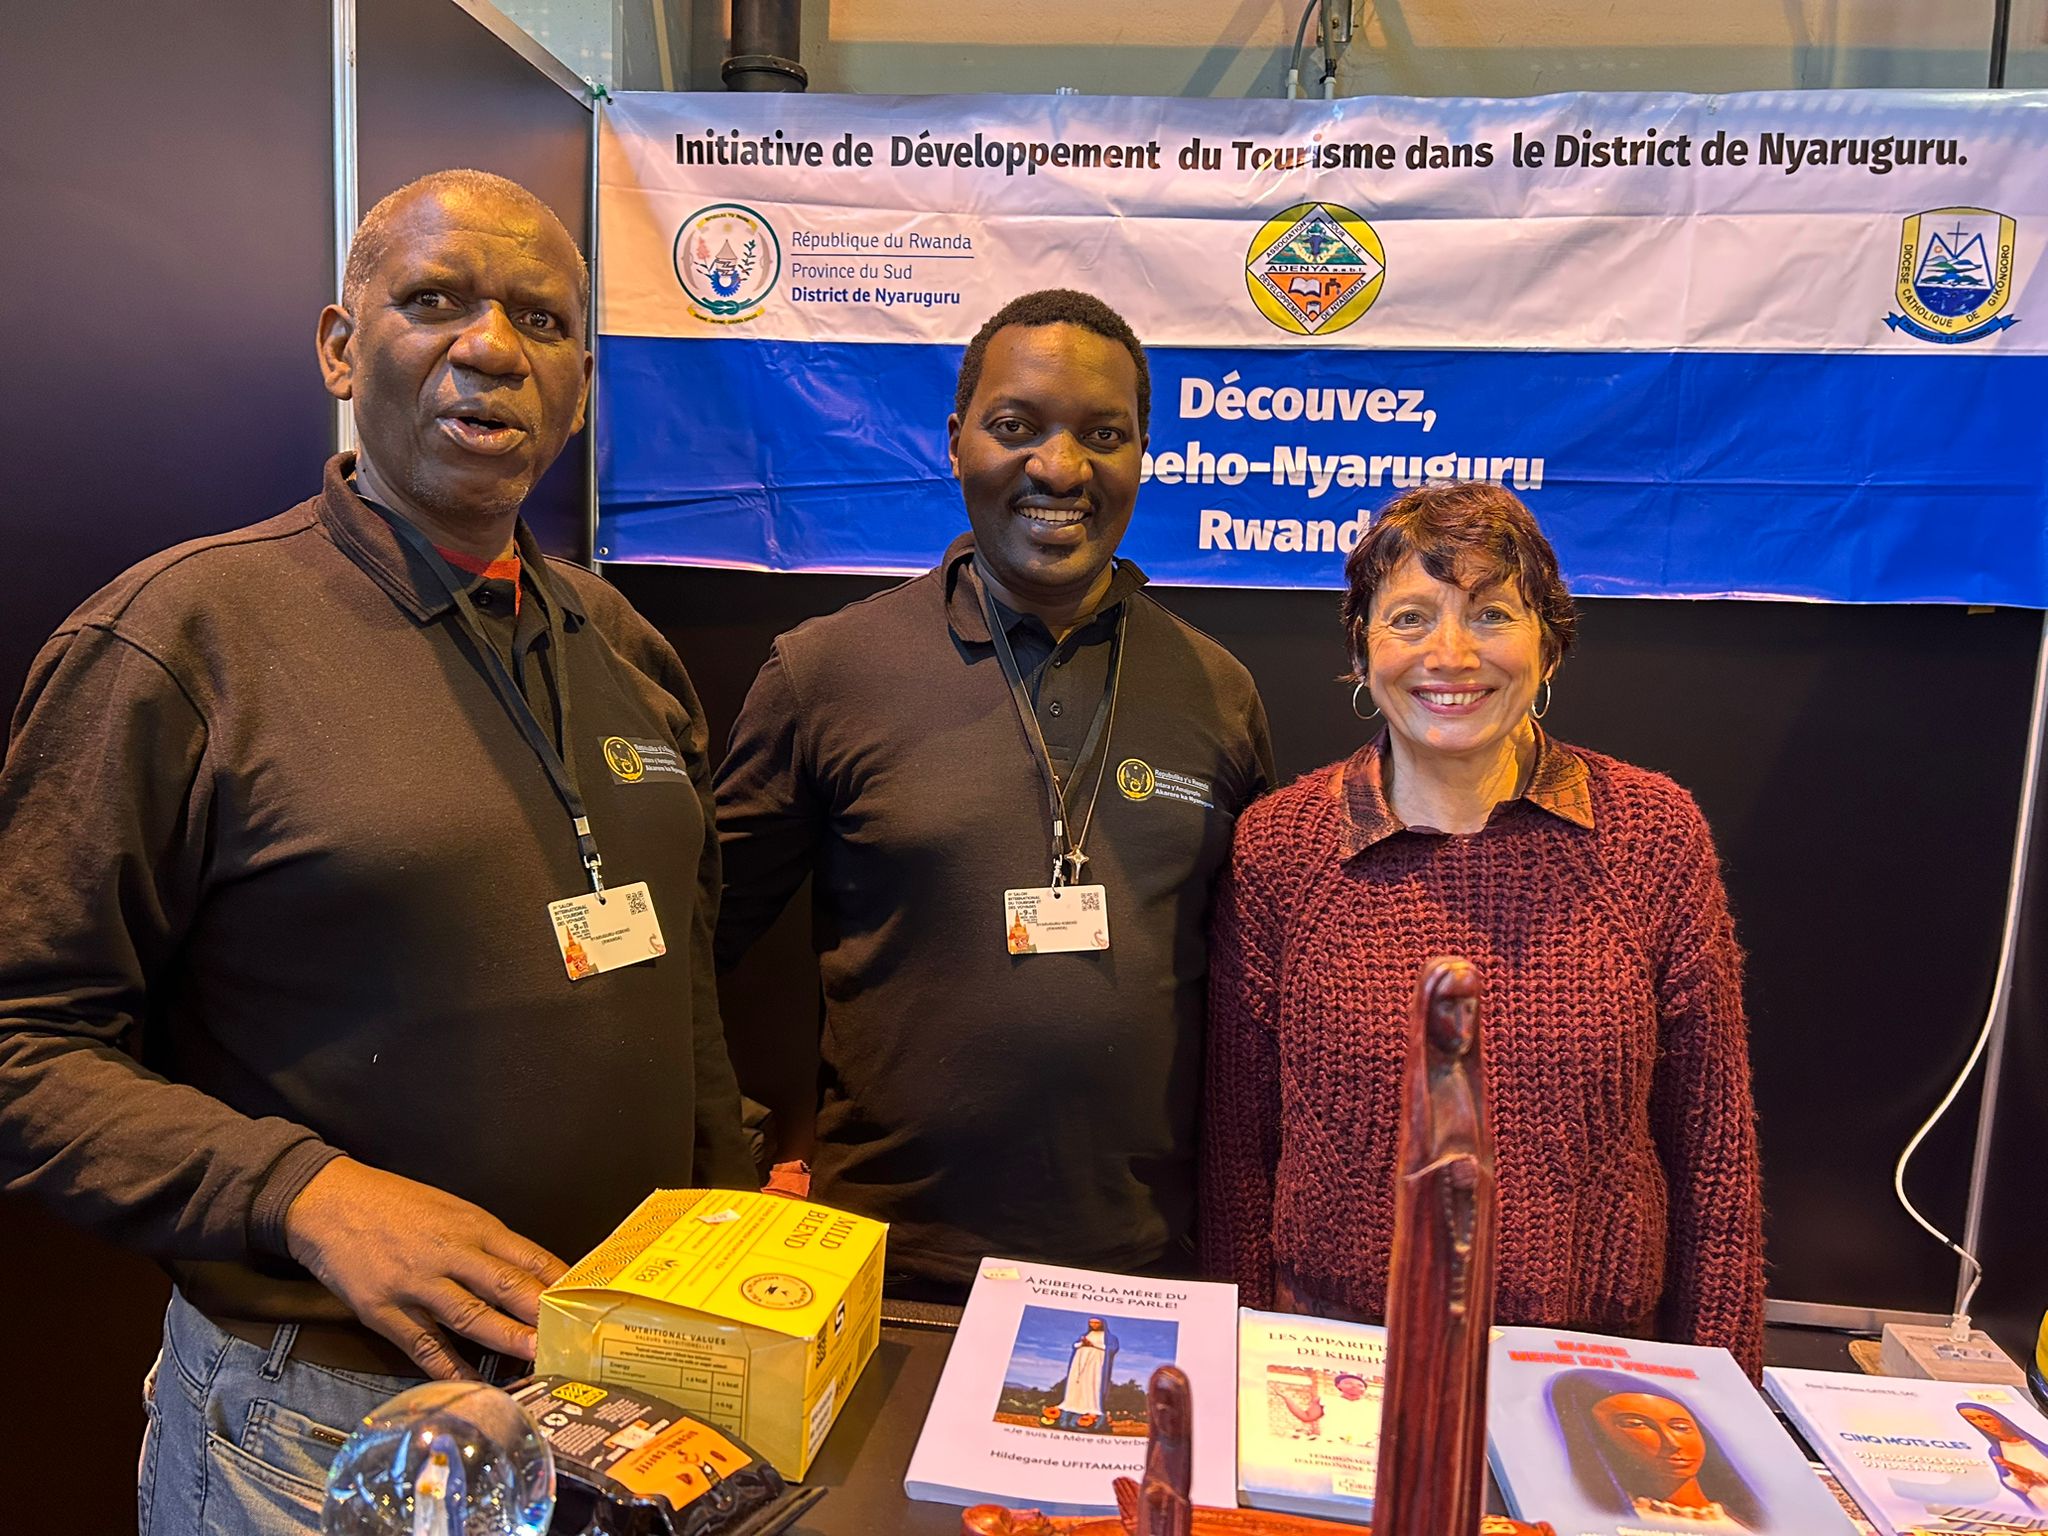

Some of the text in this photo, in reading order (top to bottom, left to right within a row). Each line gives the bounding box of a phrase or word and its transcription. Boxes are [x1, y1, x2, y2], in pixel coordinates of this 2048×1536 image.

[675, 128, 1968, 176] Initiative de Développement du Tourisme dans le District de Nyaruguru.
[792, 231, 972, 251] République du Rwanda
[1266, 221, 1307, 258] ASSOCIATION
[1327, 220, 1362, 254] POUR LE
[792, 262, 912, 279] Province du Sud
[1900, 244, 1913, 284] DIOCESE
[792, 287, 961, 307] District de Nyaruguru
[1902, 245, 2010, 328] CATHOLIQUE DE GIKONGORO
[1321, 311, 1332, 320] DE
[1179, 369, 1437, 432] Découvez,
[1198, 509, 1371, 553] Rwand
[784, 1209, 829, 1249] BLEND
[819, 1216, 857, 1249] MILD
[1032, 1286, 1179, 1309] VERBE NOUS PARLE!
[1039, 1278, 1096, 1293] KIBEHO,
[1101, 1286, 1119, 1294] LA
[1166, 1292, 1187, 1300] DU
[624, 1325, 726, 1346] NUTRITIONAL VALUES
[1269, 1332, 1388, 1352] LES APPARITI
[1297, 1347, 1321, 1357] DE
[610, 1362, 630, 1370] Energy
[1025, 1430, 1047, 1439] suis
[1050, 1432, 1061, 1440] la
[1096, 1437, 1112, 1445] du
[1840, 1432, 1882, 1444] CINQ
[1883, 1436, 1930, 1448] MOTS
[990, 1450, 1059, 1466] Hildegarde
